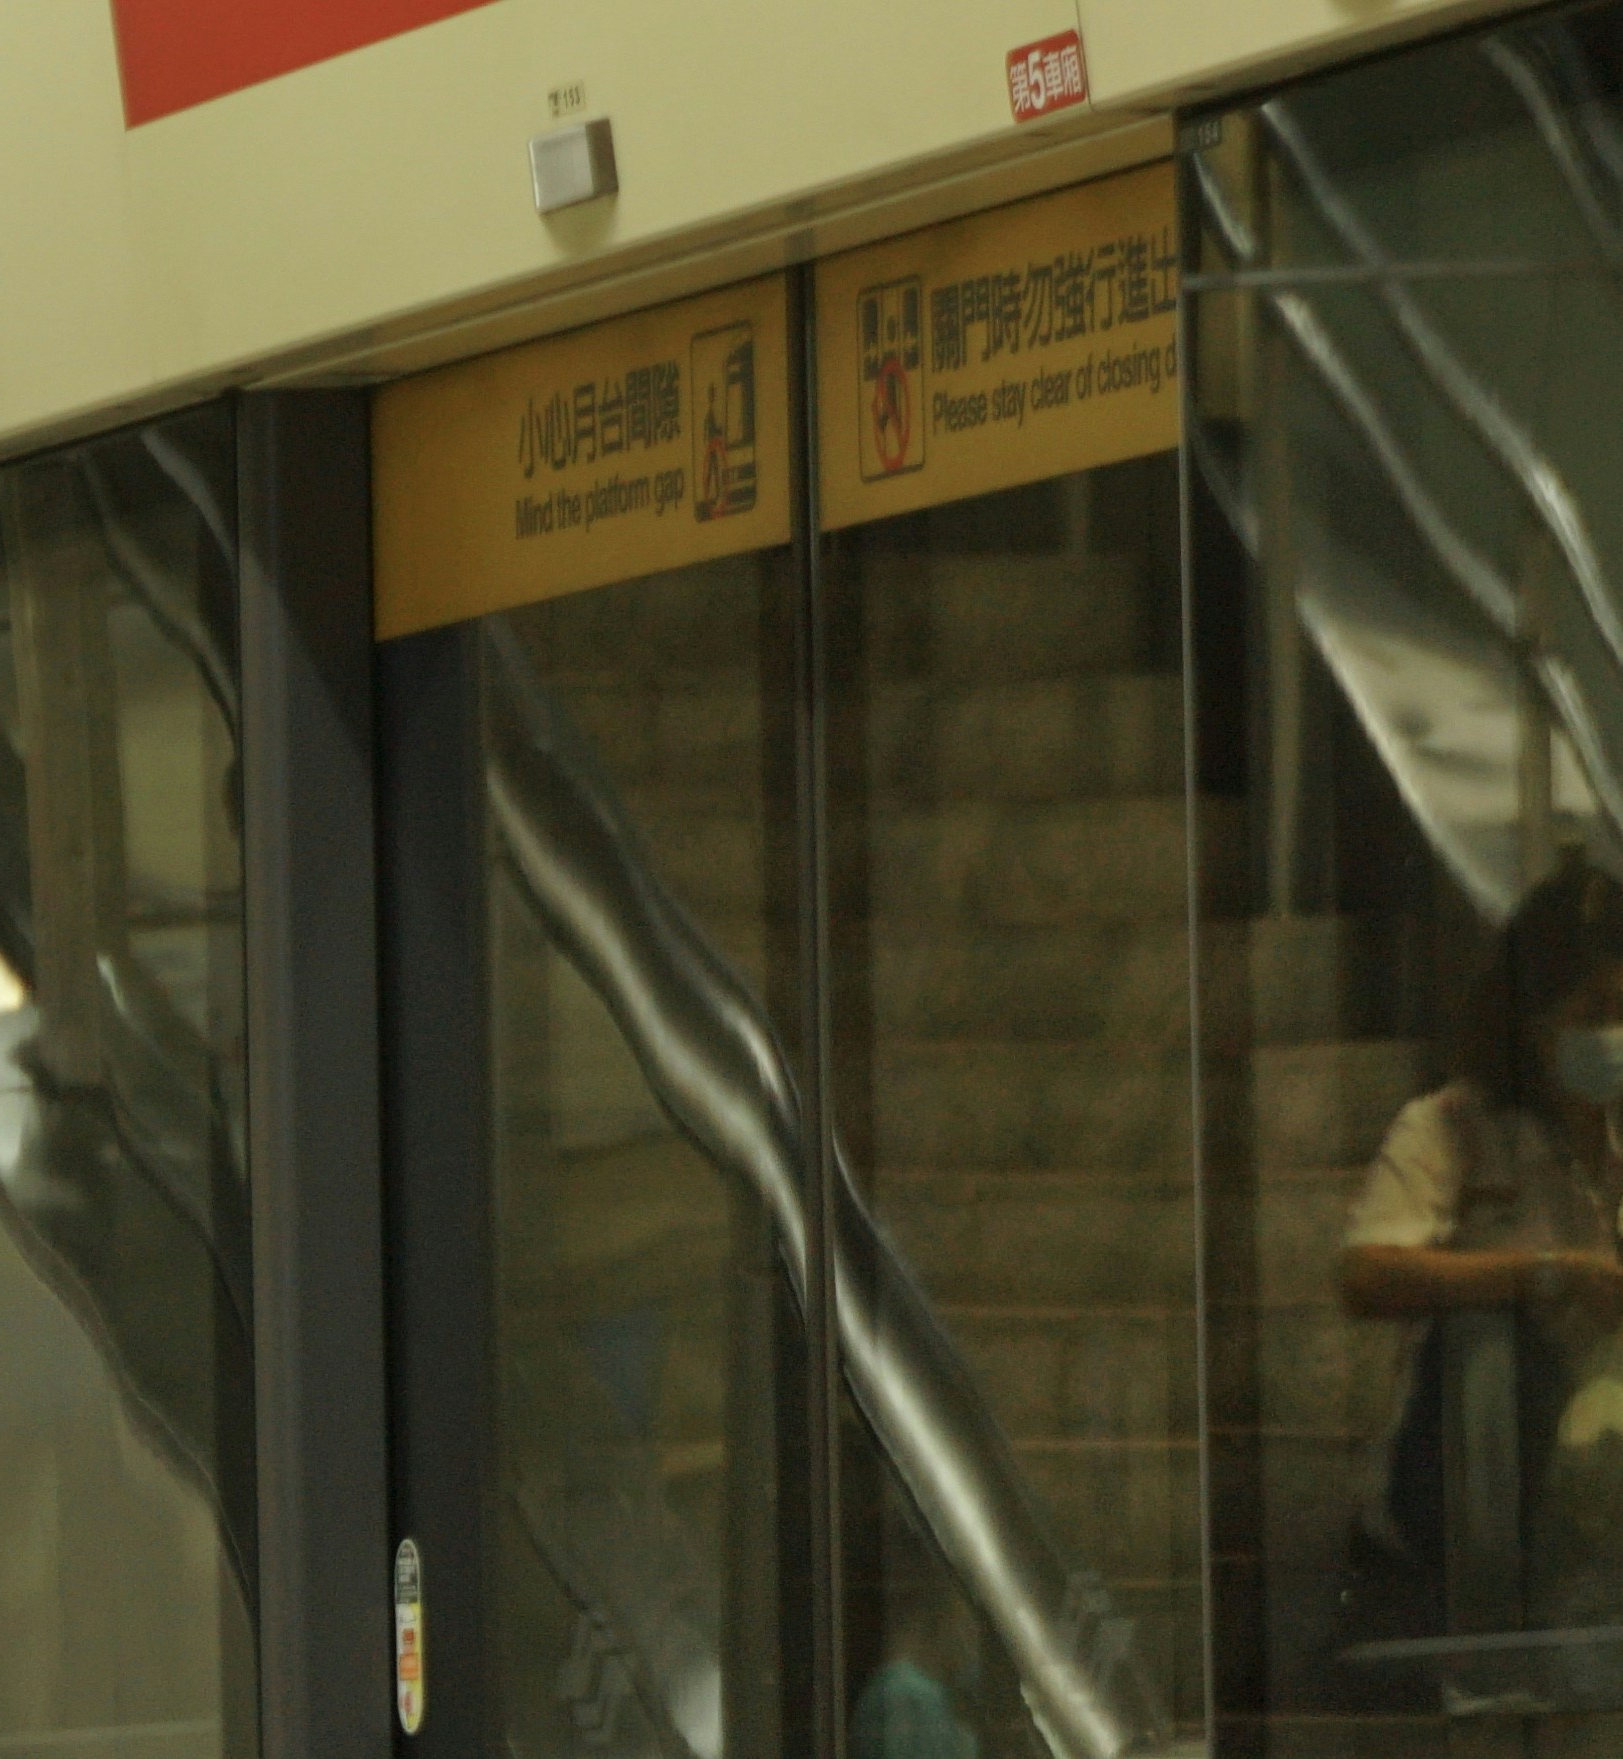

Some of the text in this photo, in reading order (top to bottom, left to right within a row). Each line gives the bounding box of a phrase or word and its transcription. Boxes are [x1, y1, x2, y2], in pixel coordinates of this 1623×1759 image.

[1010, 45, 1082, 113] 第5車廂
[518, 359, 681, 479] 小心月台間隙
[932, 388, 988, 437] Please
[991, 378, 1027, 429] stay
[1030, 365, 1073, 411] clear
[1076, 352, 1094, 400] of
[1097, 342, 1161, 394] closing
[515, 468, 685, 541] Mind the platform gap
